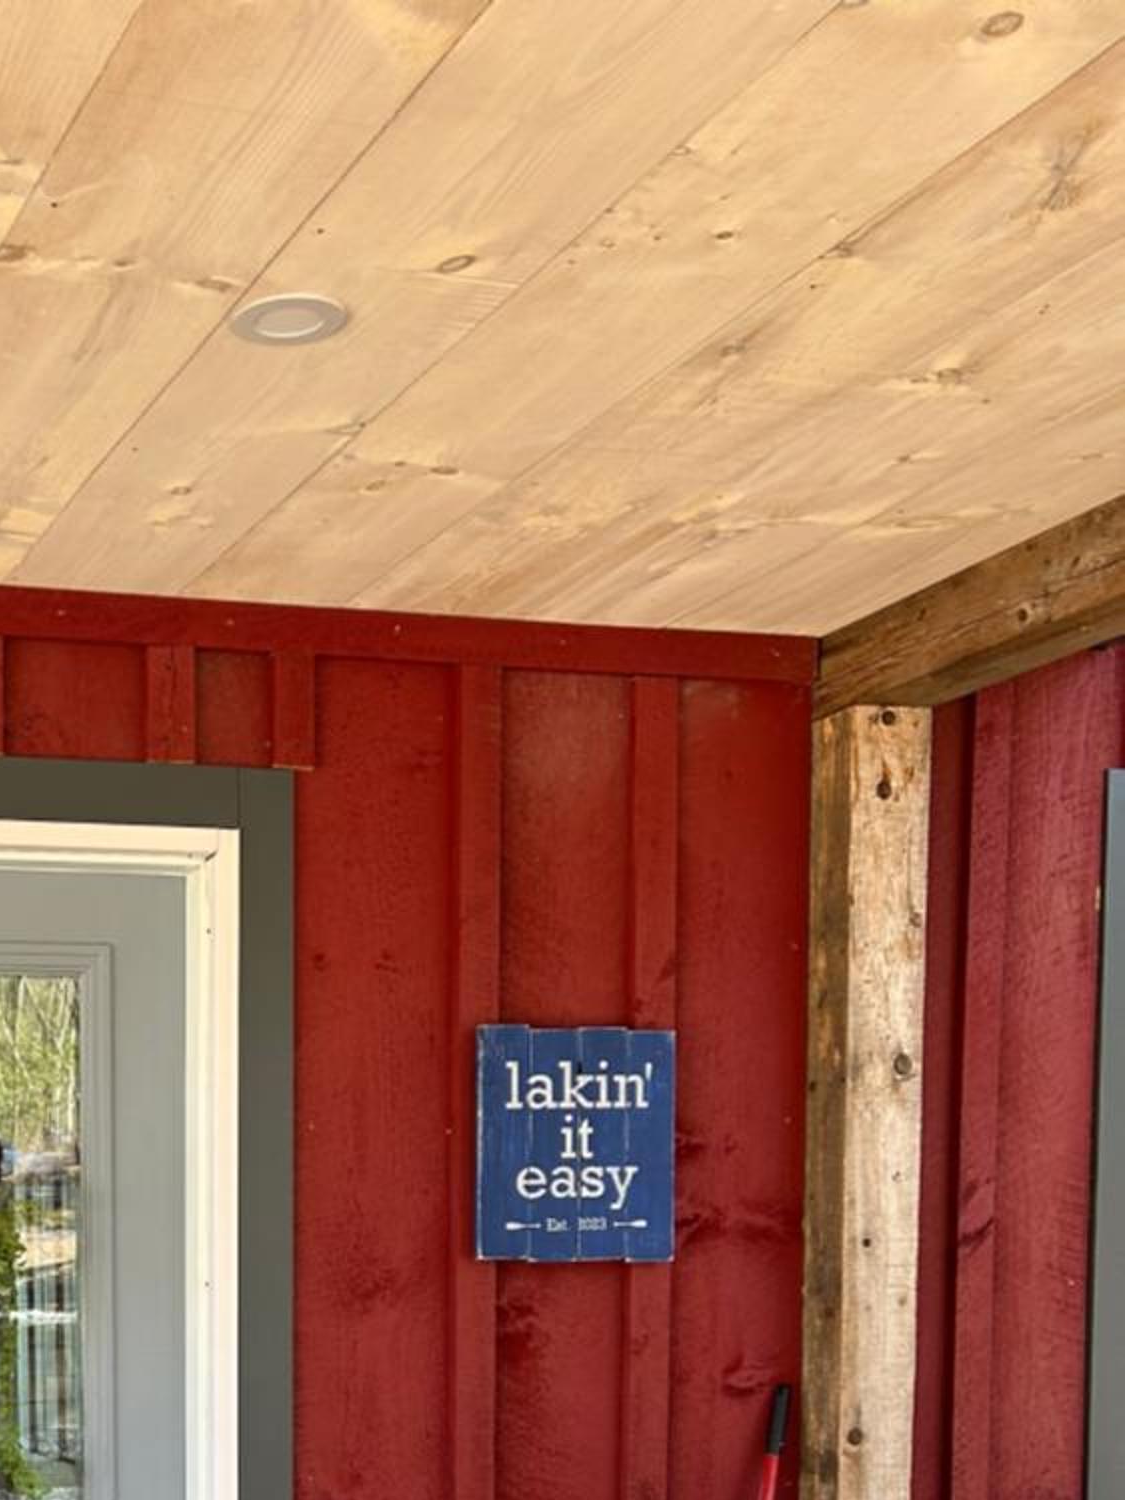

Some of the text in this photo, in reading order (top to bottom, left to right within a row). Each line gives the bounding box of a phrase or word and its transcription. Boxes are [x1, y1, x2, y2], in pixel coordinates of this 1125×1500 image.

[505, 1060, 653, 1110] lakin'
[560, 1114, 594, 1159] it
[515, 1165, 639, 1210] easy
